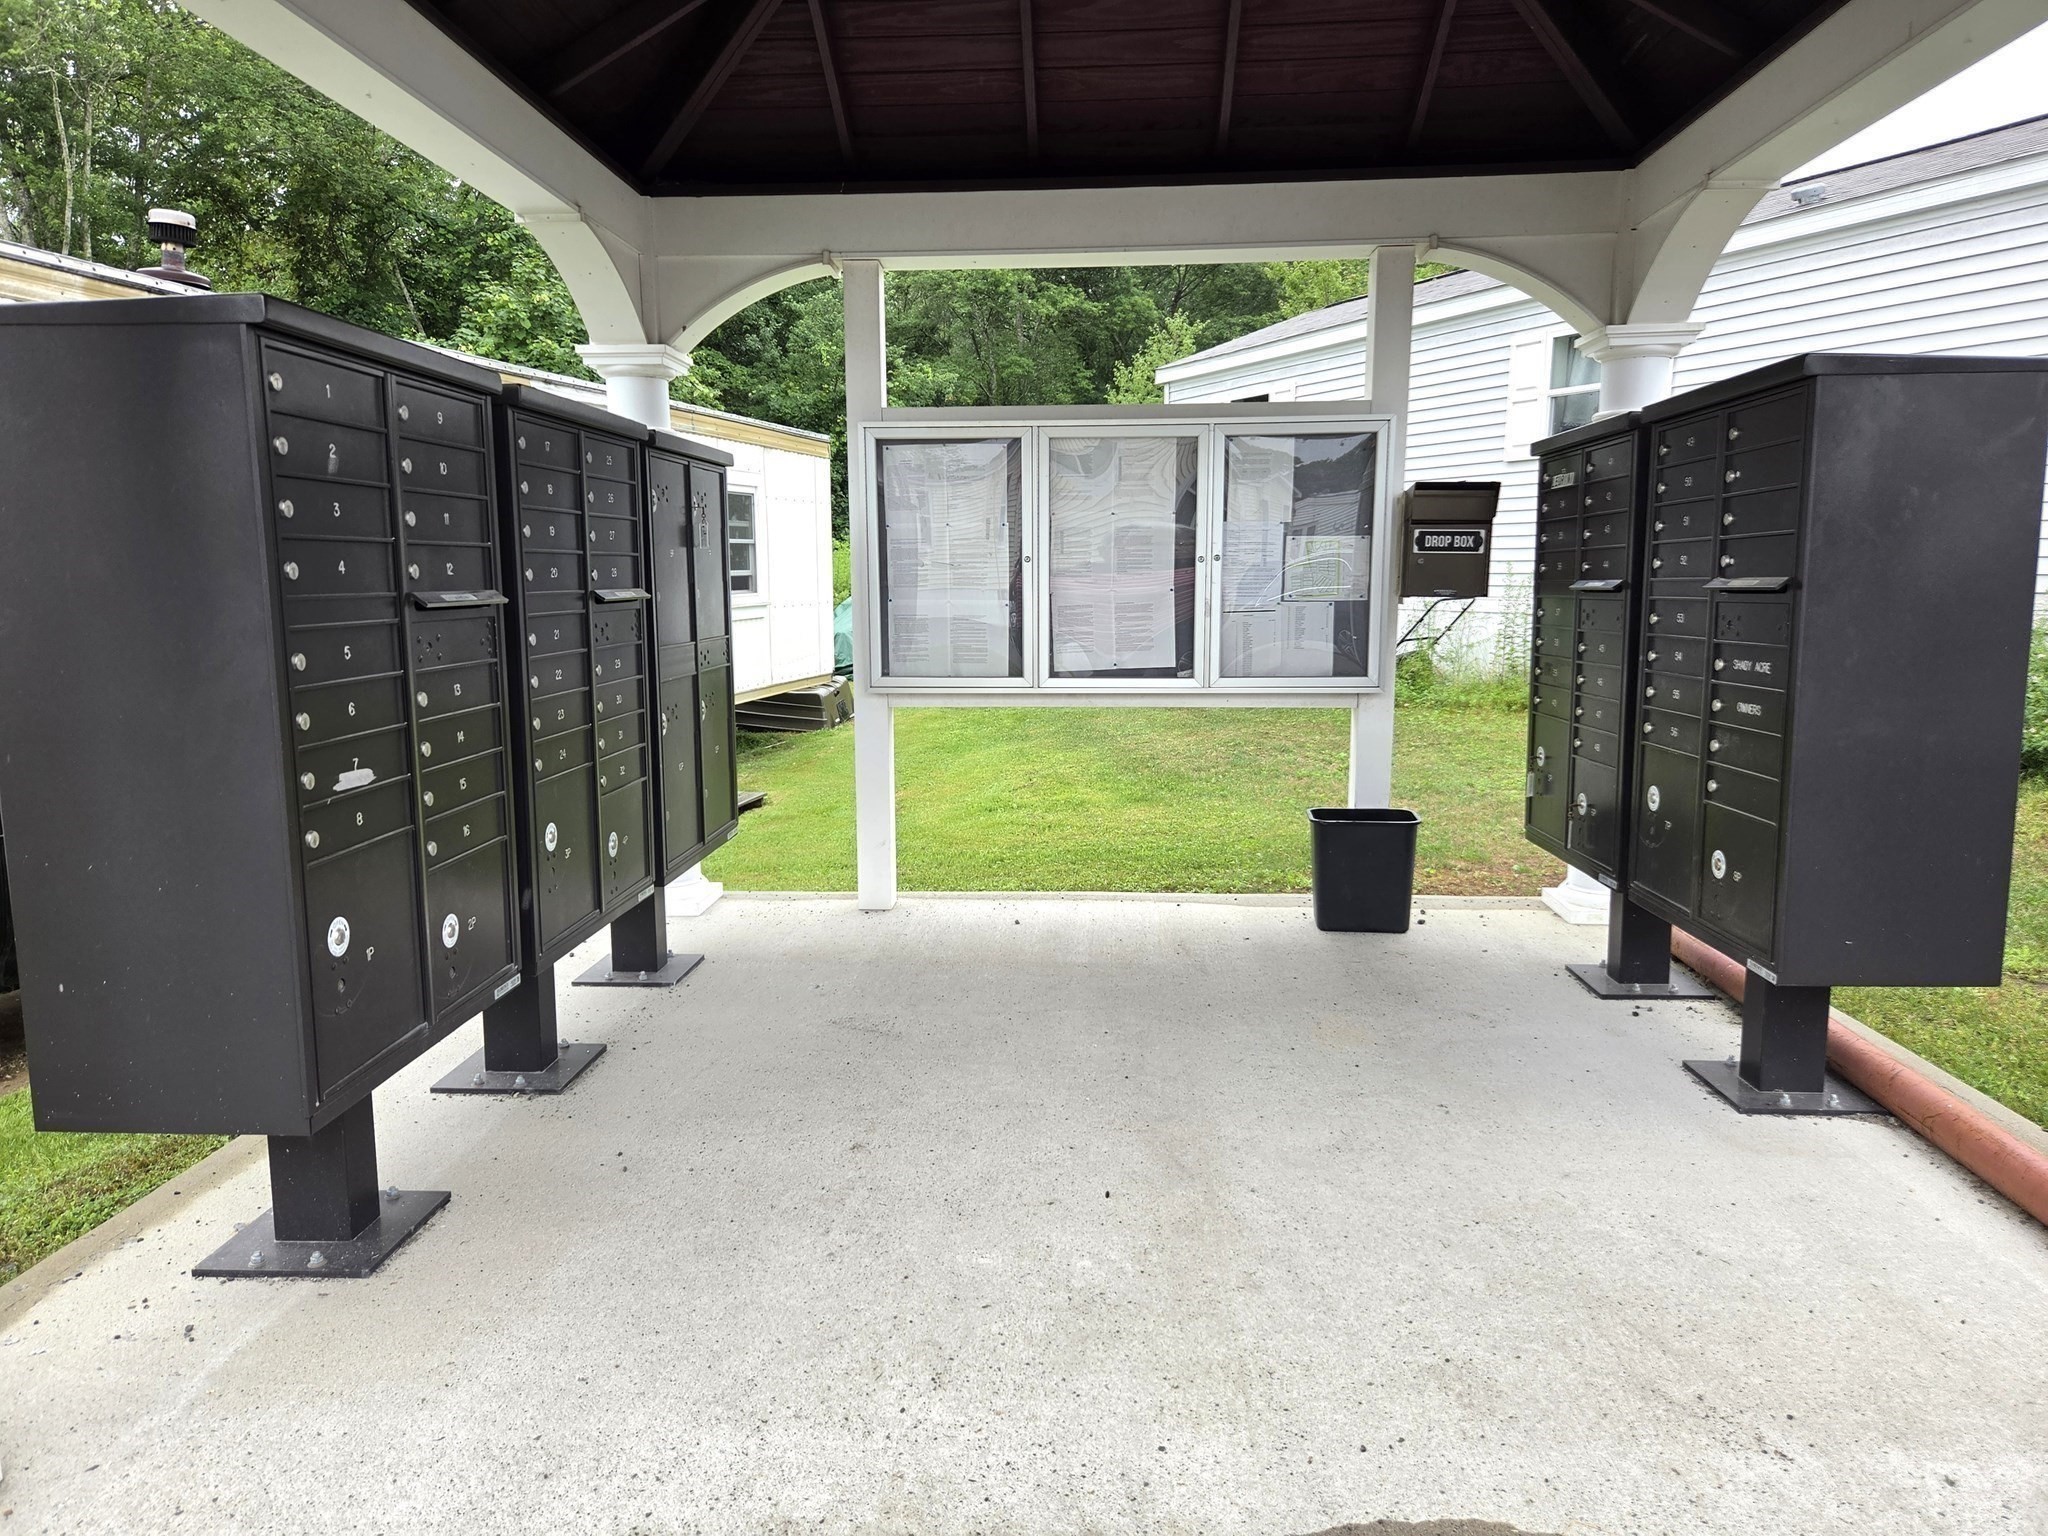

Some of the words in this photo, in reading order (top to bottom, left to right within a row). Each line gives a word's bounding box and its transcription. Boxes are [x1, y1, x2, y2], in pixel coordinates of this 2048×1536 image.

[325, 383, 331, 399] 1
[436, 411, 443, 425] 9
[328, 442, 337, 458] 2
[439, 461, 448, 476] 10
[1684, 476, 1693, 487] 50
[547, 483, 554, 495] 18
[607, 492, 614, 504] 26
[333, 502, 341, 518] 3
[443, 512, 451, 526] 11
[548, 525, 556, 537] 19
[1424, 535, 1451, 548] DROP
[1453, 535, 1475, 548] BOX
[1679, 555, 1688, 566] 52
[338, 560, 346, 575] 4
[446, 562, 454, 576] 12
[550, 567, 559, 579] 20
[611, 567, 618, 578] 28
[1676, 612, 1685, 624] 53
[553, 629, 560, 640] 21
[343, 645, 352, 661] 5
[1674, 651, 1683, 661] 54
[614, 658, 622, 669] 29
[1732, 659, 1753, 672] SHADY
[1754, 661, 1772, 675] ACRE
[555, 669, 563, 681] 22
[453, 683, 462, 696] 13
[1672, 689, 1681, 700] 55
[348, 701, 356, 717] 6
[557, 708, 565, 721] 23
[1736, 701, 1762, 716] OWNERS
[456, 730, 465, 743] 14
[559, 748, 567, 760] 24
[352, 757, 359, 771] 7
[619, 765, 626, 776] 32
[459, 777, 467, 791] 15
[356, 811, 364, 826] 8
[1664, 820, 1672, 830] 7P
[462, 824, 471, 837] 16
[564, 847, 572, 860] 3P
[1732, 870, 1743, 882] 8P
[467, 916, 477, 931] 2P
[365, 946, 375, 962] 1P
